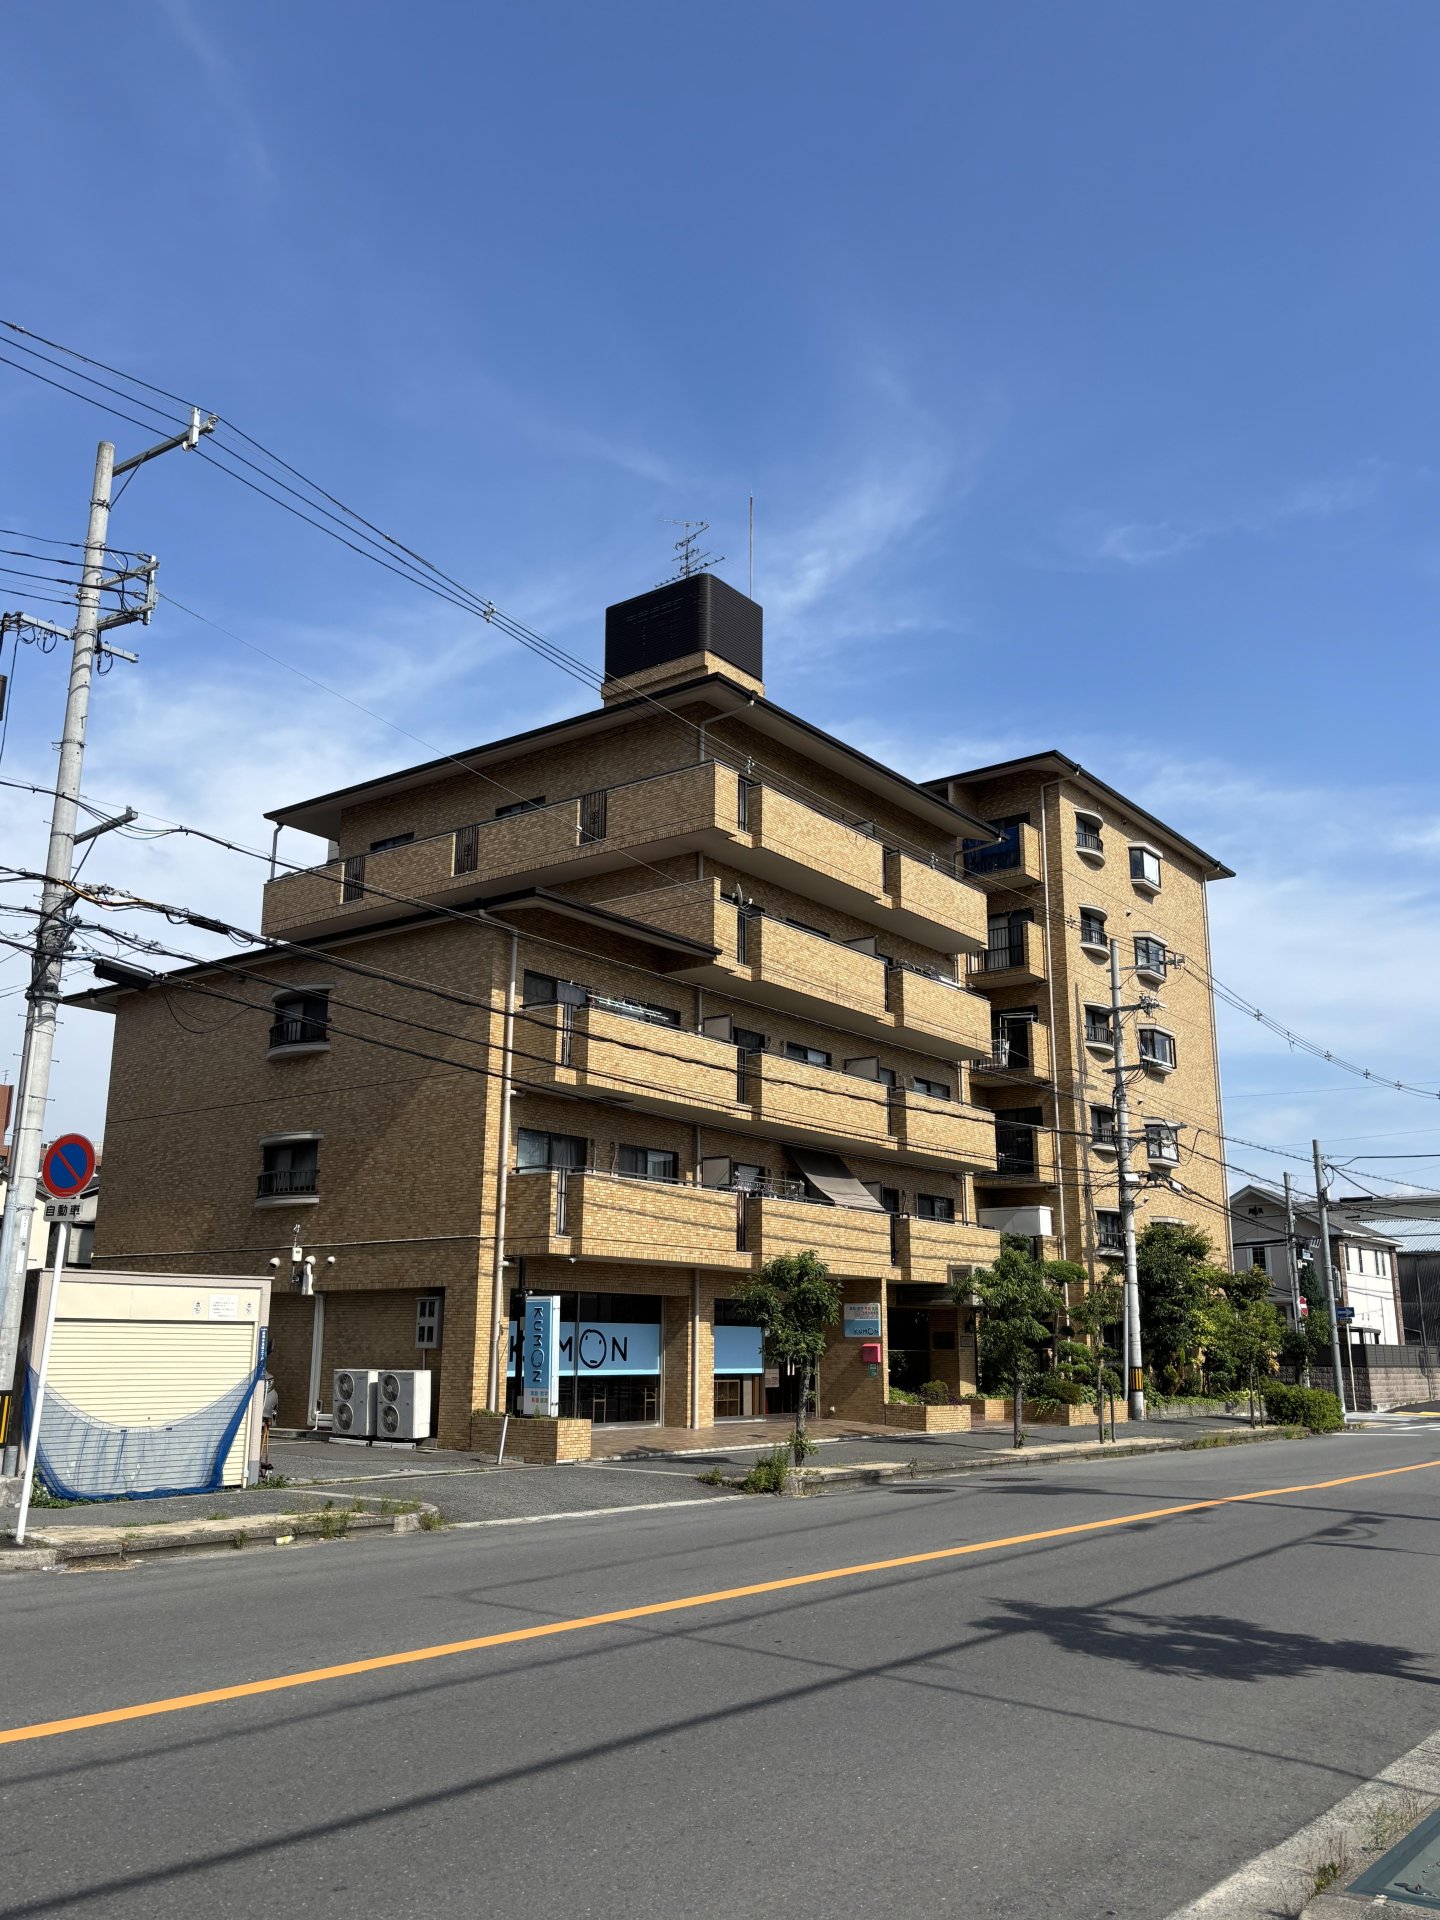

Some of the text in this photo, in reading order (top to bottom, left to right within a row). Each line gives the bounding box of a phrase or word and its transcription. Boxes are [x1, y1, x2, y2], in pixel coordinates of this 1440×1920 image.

[45, 1204, 81, 1219] 自動車
[531, 1306, 545, 1383] KUMON
[853, 1327, 879, 1336] KUMON
[509, 1329, 628, 1369] KMON
